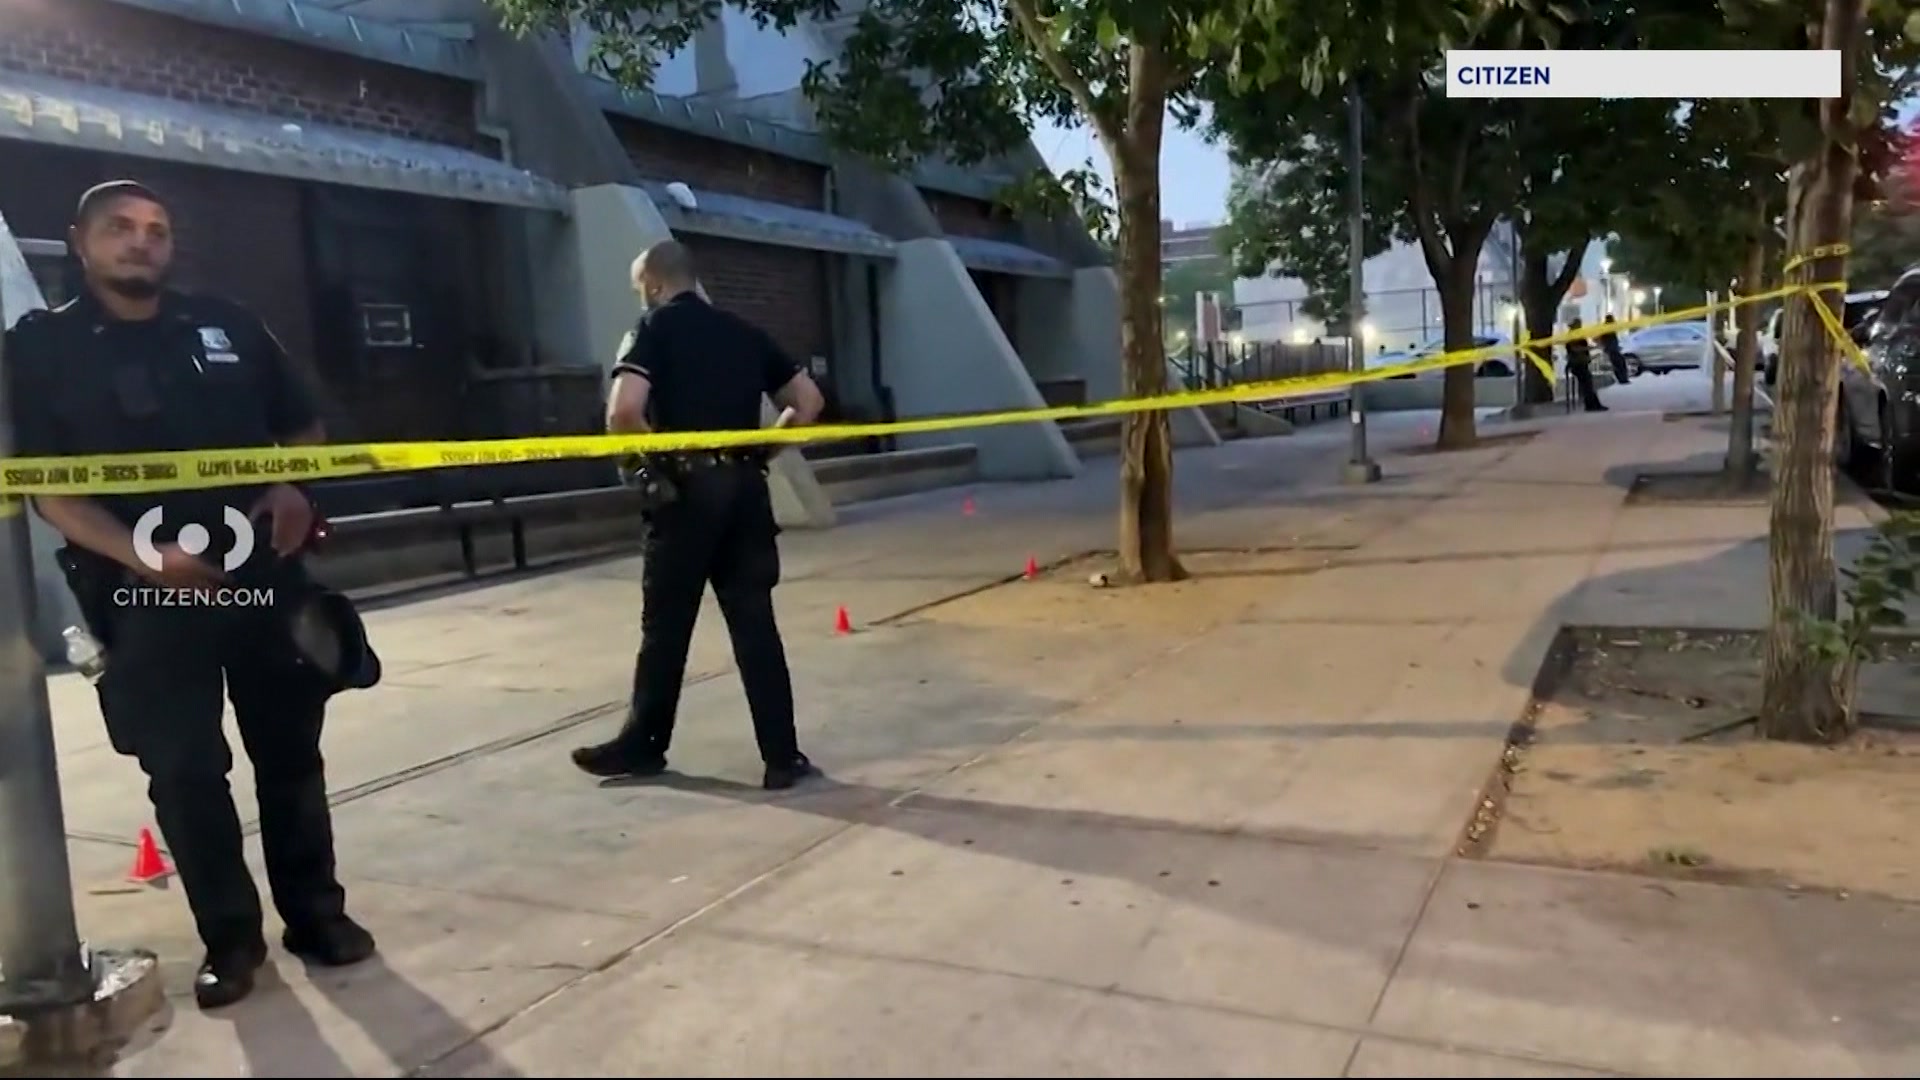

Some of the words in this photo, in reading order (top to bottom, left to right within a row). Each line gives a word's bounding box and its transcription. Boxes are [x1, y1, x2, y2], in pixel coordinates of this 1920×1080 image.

[4, 469, 44, 486] CROSS
[47, 468, 69, 485] NOT
[73, 467, 89, 484] DO
